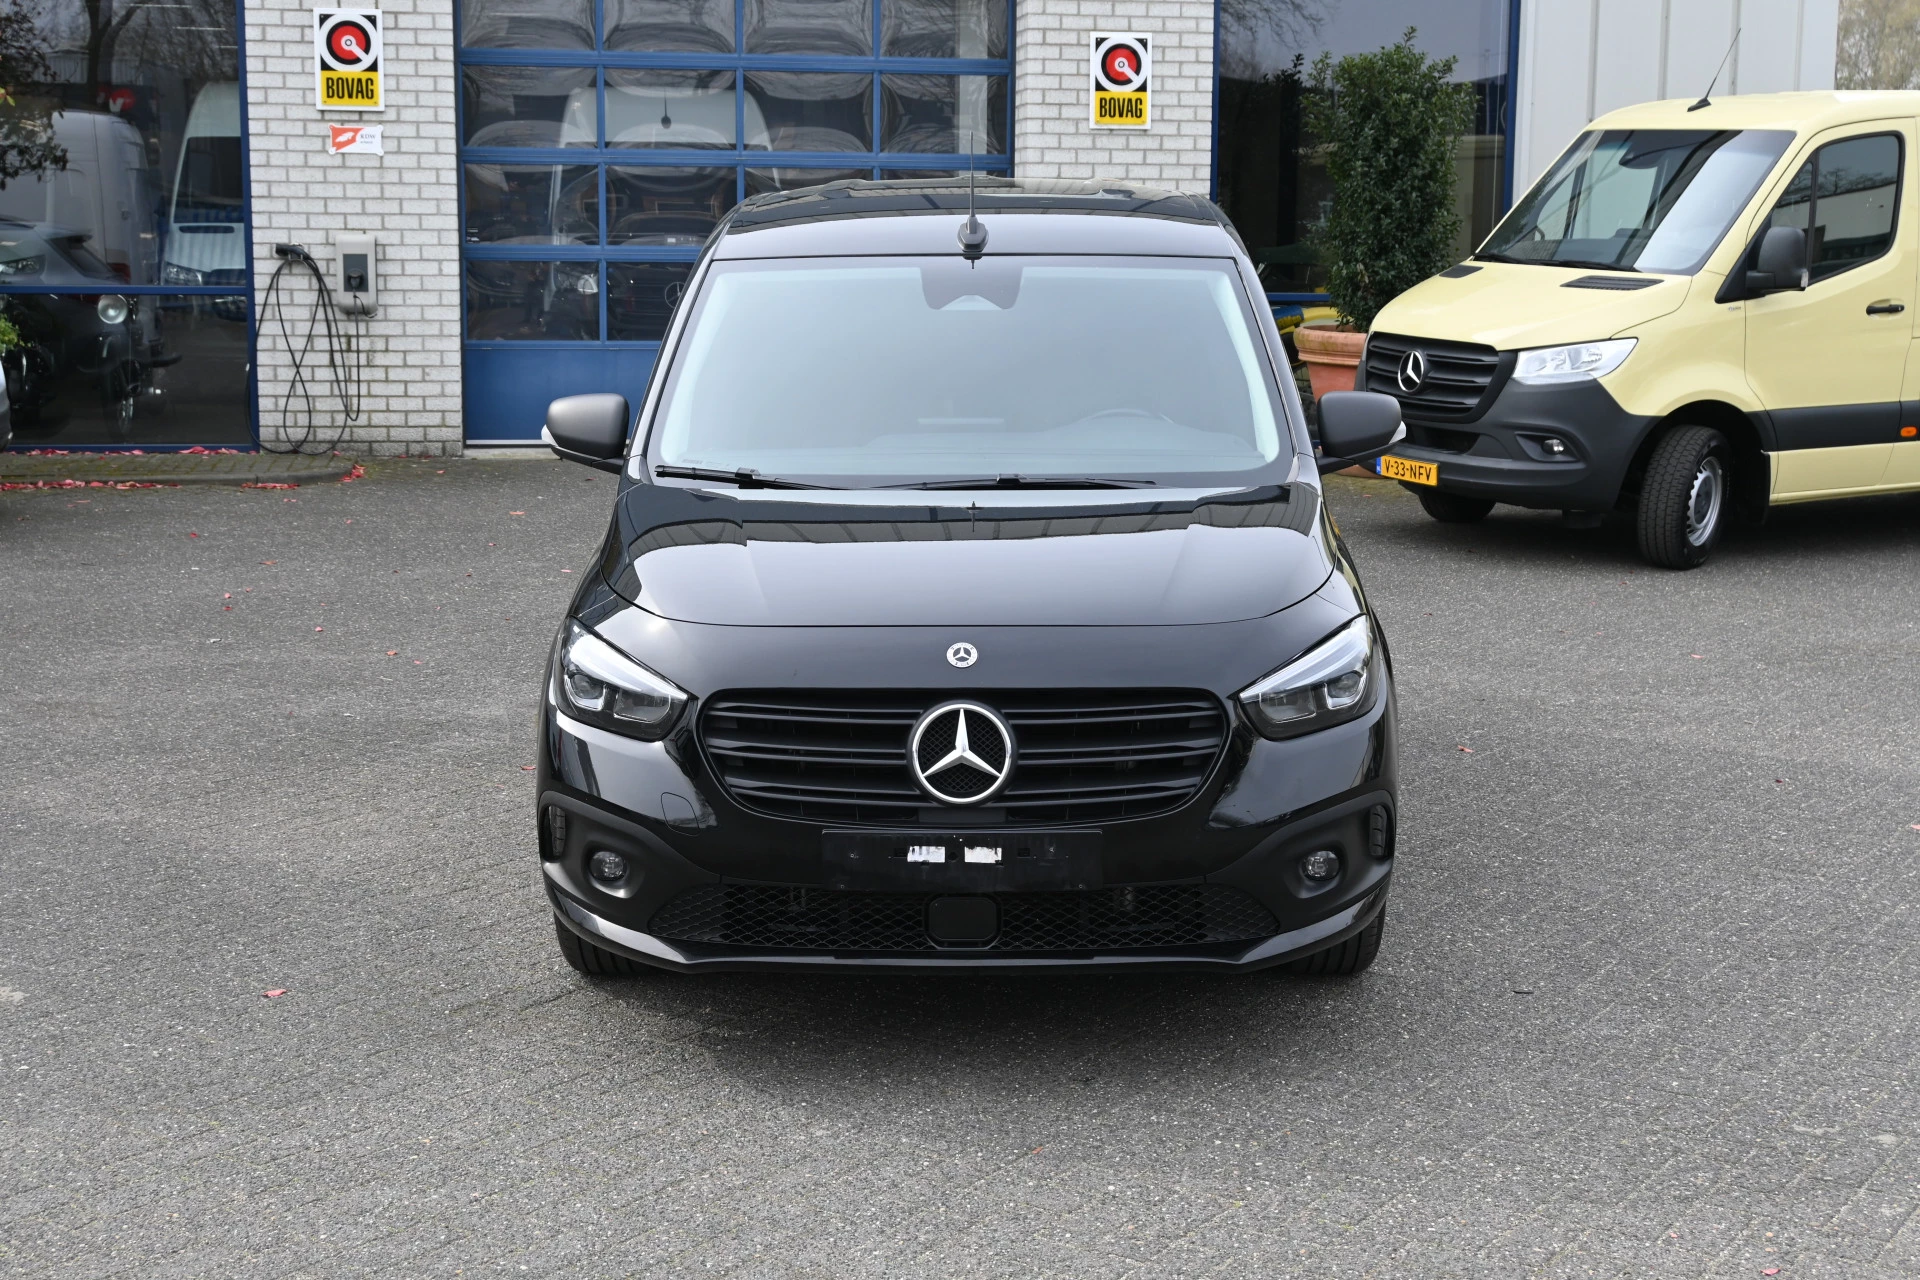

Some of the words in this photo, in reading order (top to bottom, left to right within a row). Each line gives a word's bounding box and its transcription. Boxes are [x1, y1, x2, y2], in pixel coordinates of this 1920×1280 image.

[326, 77, 374, 99] BOVAG
[1100, 97, 1143, 118] BOVAG
[1385, 458, 1432, 482] V-33-NFV
